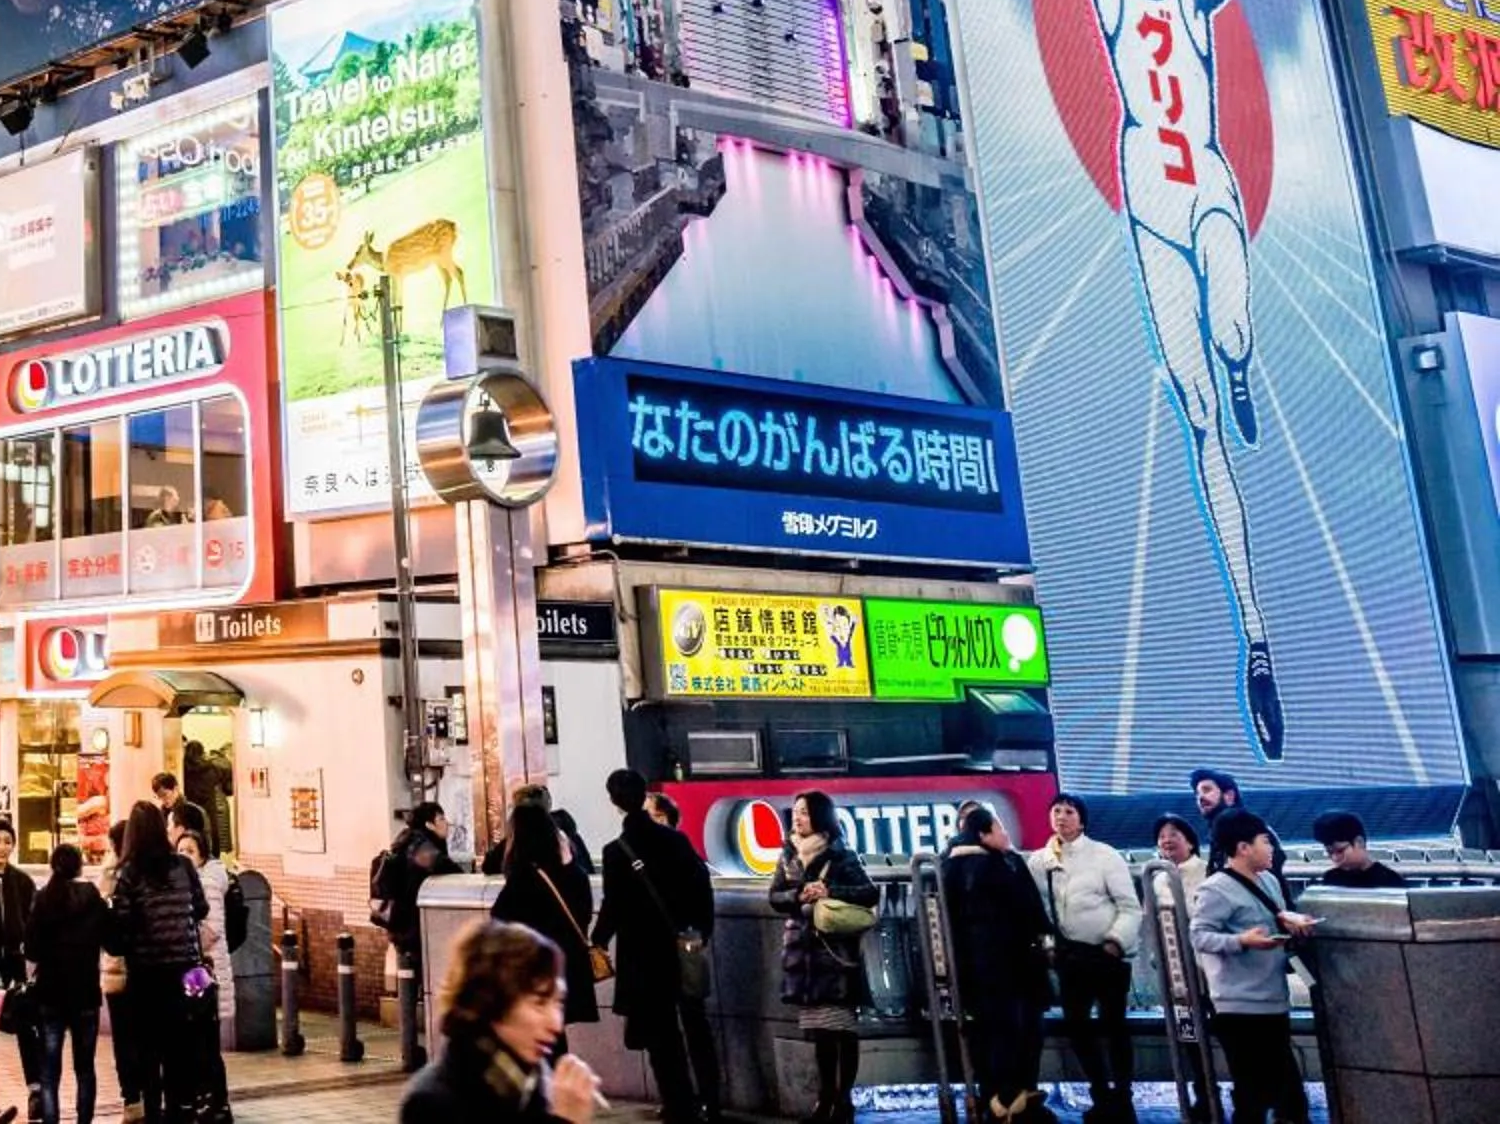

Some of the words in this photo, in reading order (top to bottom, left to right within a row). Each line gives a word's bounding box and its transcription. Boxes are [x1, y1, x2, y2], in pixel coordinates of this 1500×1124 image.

[284, 69, 368, 123] Travel
[373, 75, 393, 94] to
[395, 42, 468, 81] Nara
[1136, 8, 1197, 185] グリコ
[55, 327, 218, 396] LOTTERIA
[781, 511, 878, 540] 雪印メグミルク
[217, 613, 282, 639] Toilets
[536, 610, 588, 636] oilets
[714, 608, 819, 635] 店舗情報館
